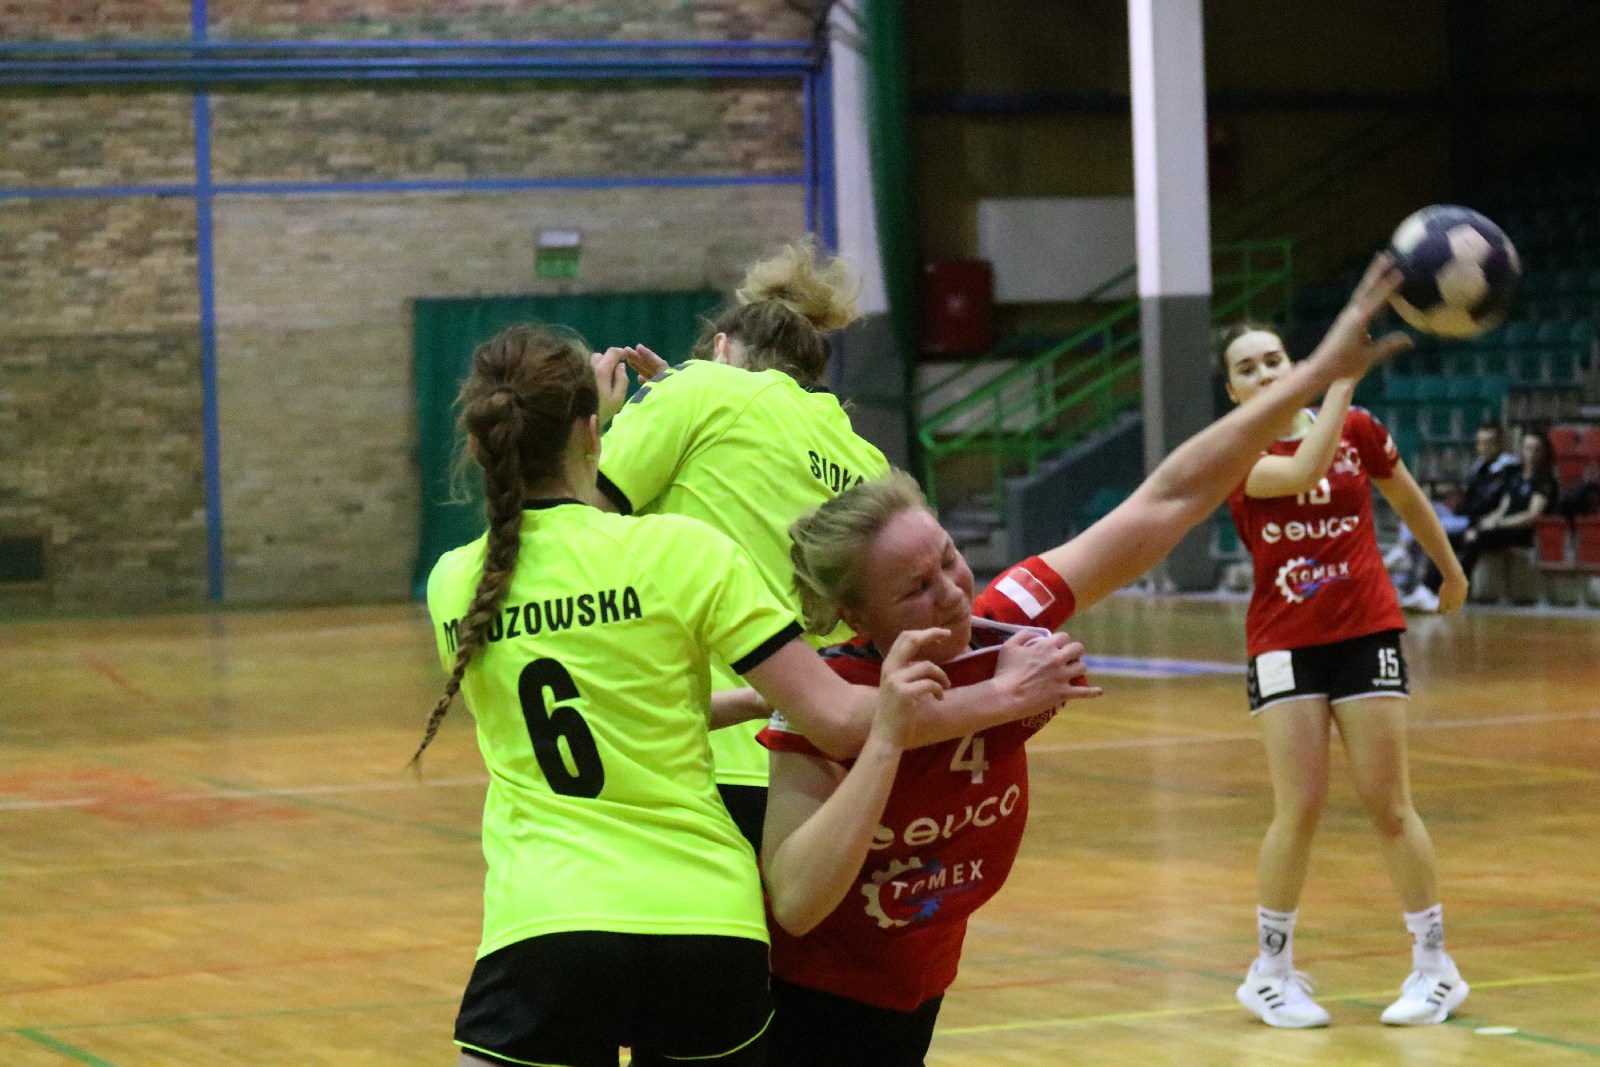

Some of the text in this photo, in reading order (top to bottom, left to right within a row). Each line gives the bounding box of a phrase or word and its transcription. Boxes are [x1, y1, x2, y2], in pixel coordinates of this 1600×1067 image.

[1288, 562, 1349, 584] TOMEX
[443, 586, 643, 654] MOZOWSKA
[1378, 647, 1399, 678] 15
[518, 657, 605, 799] 6
[950, 734, 989, 784] 4
[892, 858, 984, 900] TOMEX
